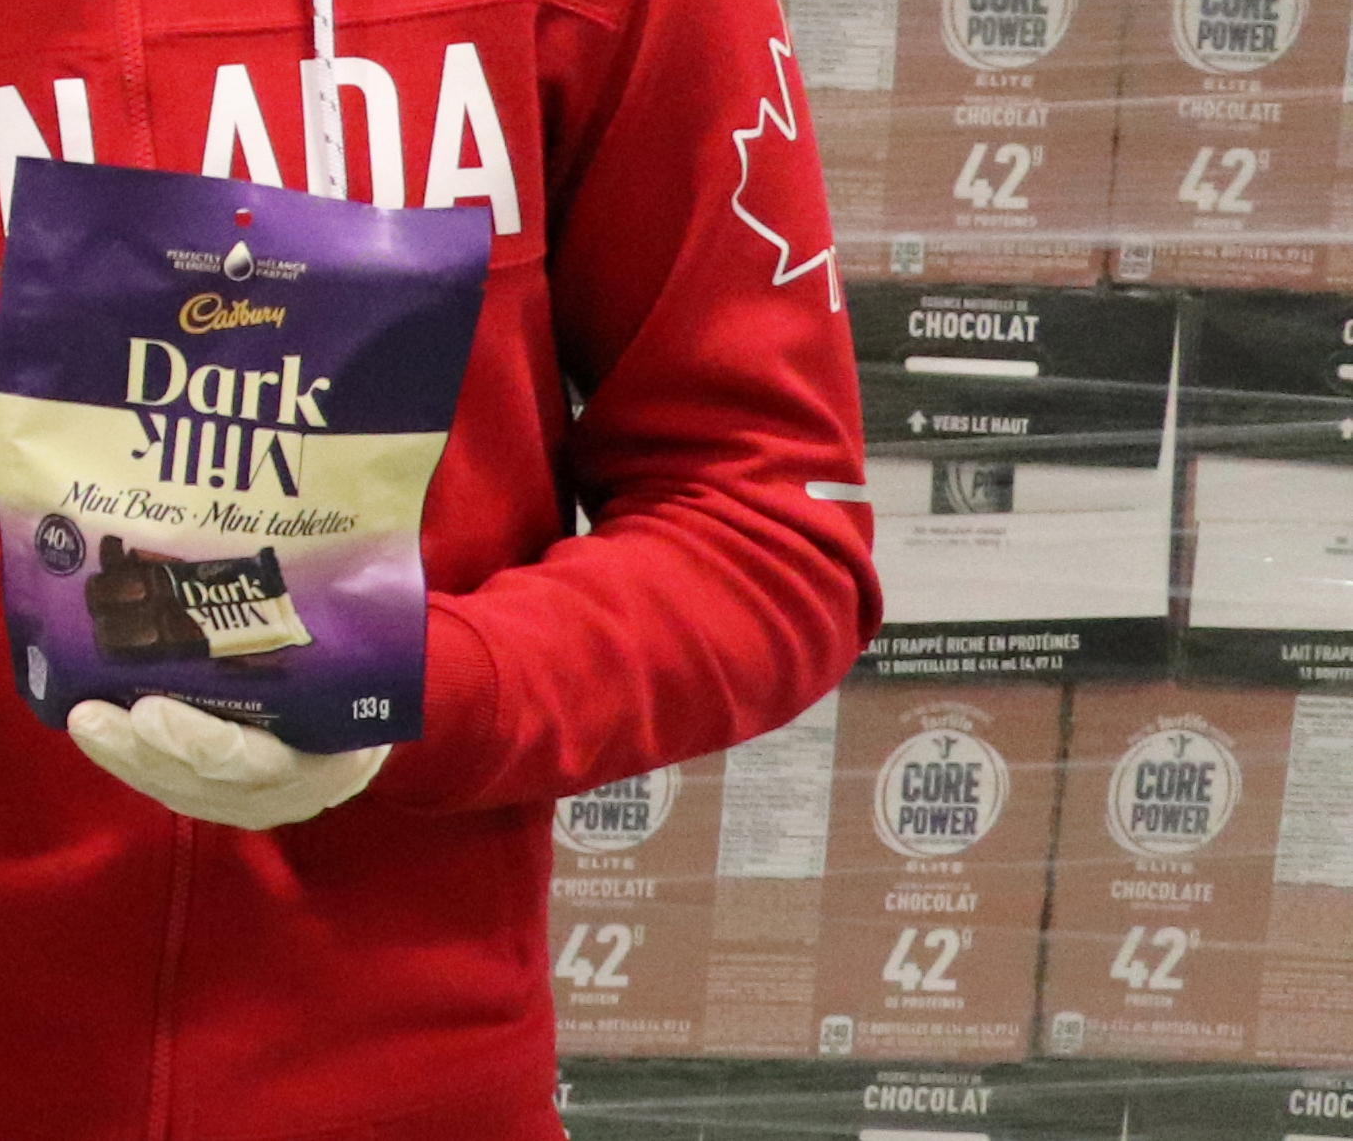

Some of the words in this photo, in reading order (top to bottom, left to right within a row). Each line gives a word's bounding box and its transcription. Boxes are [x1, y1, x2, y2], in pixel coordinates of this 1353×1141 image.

[966, 16, 1048, 48] POWER
[1197, 21, 1279, 53] POWER
[954, 105, 1049, 128] CHOCOLAT
[1177, 96, 1283, 123] CHOCOLATE
[166, 249, 221, 263] PERFECTLY
[178, 291, 287, 335] Cadbury
[908, 310, 1040, 343] CHOCOLAT
[124, 335, 332, 429] Dark
[932, 414, 970, 432] VERS
[972, 416, 989, 434] LE
[991, 417, 1030, 435] HAUT
[130, 409, 305, 498] Milk
[58, 480, 125, 516] Mini
[124, 488, 187, 525] Bars
[199, 499, 264, 535] Mini
[266, 509, 360, 539] tablettes
[182, 573, 266, 607] Dark
[861, 638, 889, 655] AIT
[893, 634, 943, 654] FRAPPÉ
[946, 635, 985, 653] RICHE
[988, 634, 1006, 652] EN
[1009, 631, 1081, 651] PROTÉINES
[1281, 644, 1312, 660] LAIT
[893, 657, 961, 674] BOUTEILLES
[963, 657, 977, 672] DE
[902, 761, 982, 805] CORE
[1134, 761, 1216, 804] CORE
[570, 801, 651, 832] POWER
[898, 806, 978, 836] POWER
[1131, 804, 1211, 835] POWER
[552, 878, 657, 900] CHOCOLATE
[884, 892, 978, 913] CHOCOLAT
[1110, 880, 1214, 903] CHOCOLATE
[863, 1085, 991, 1116] CHOCOLAT
